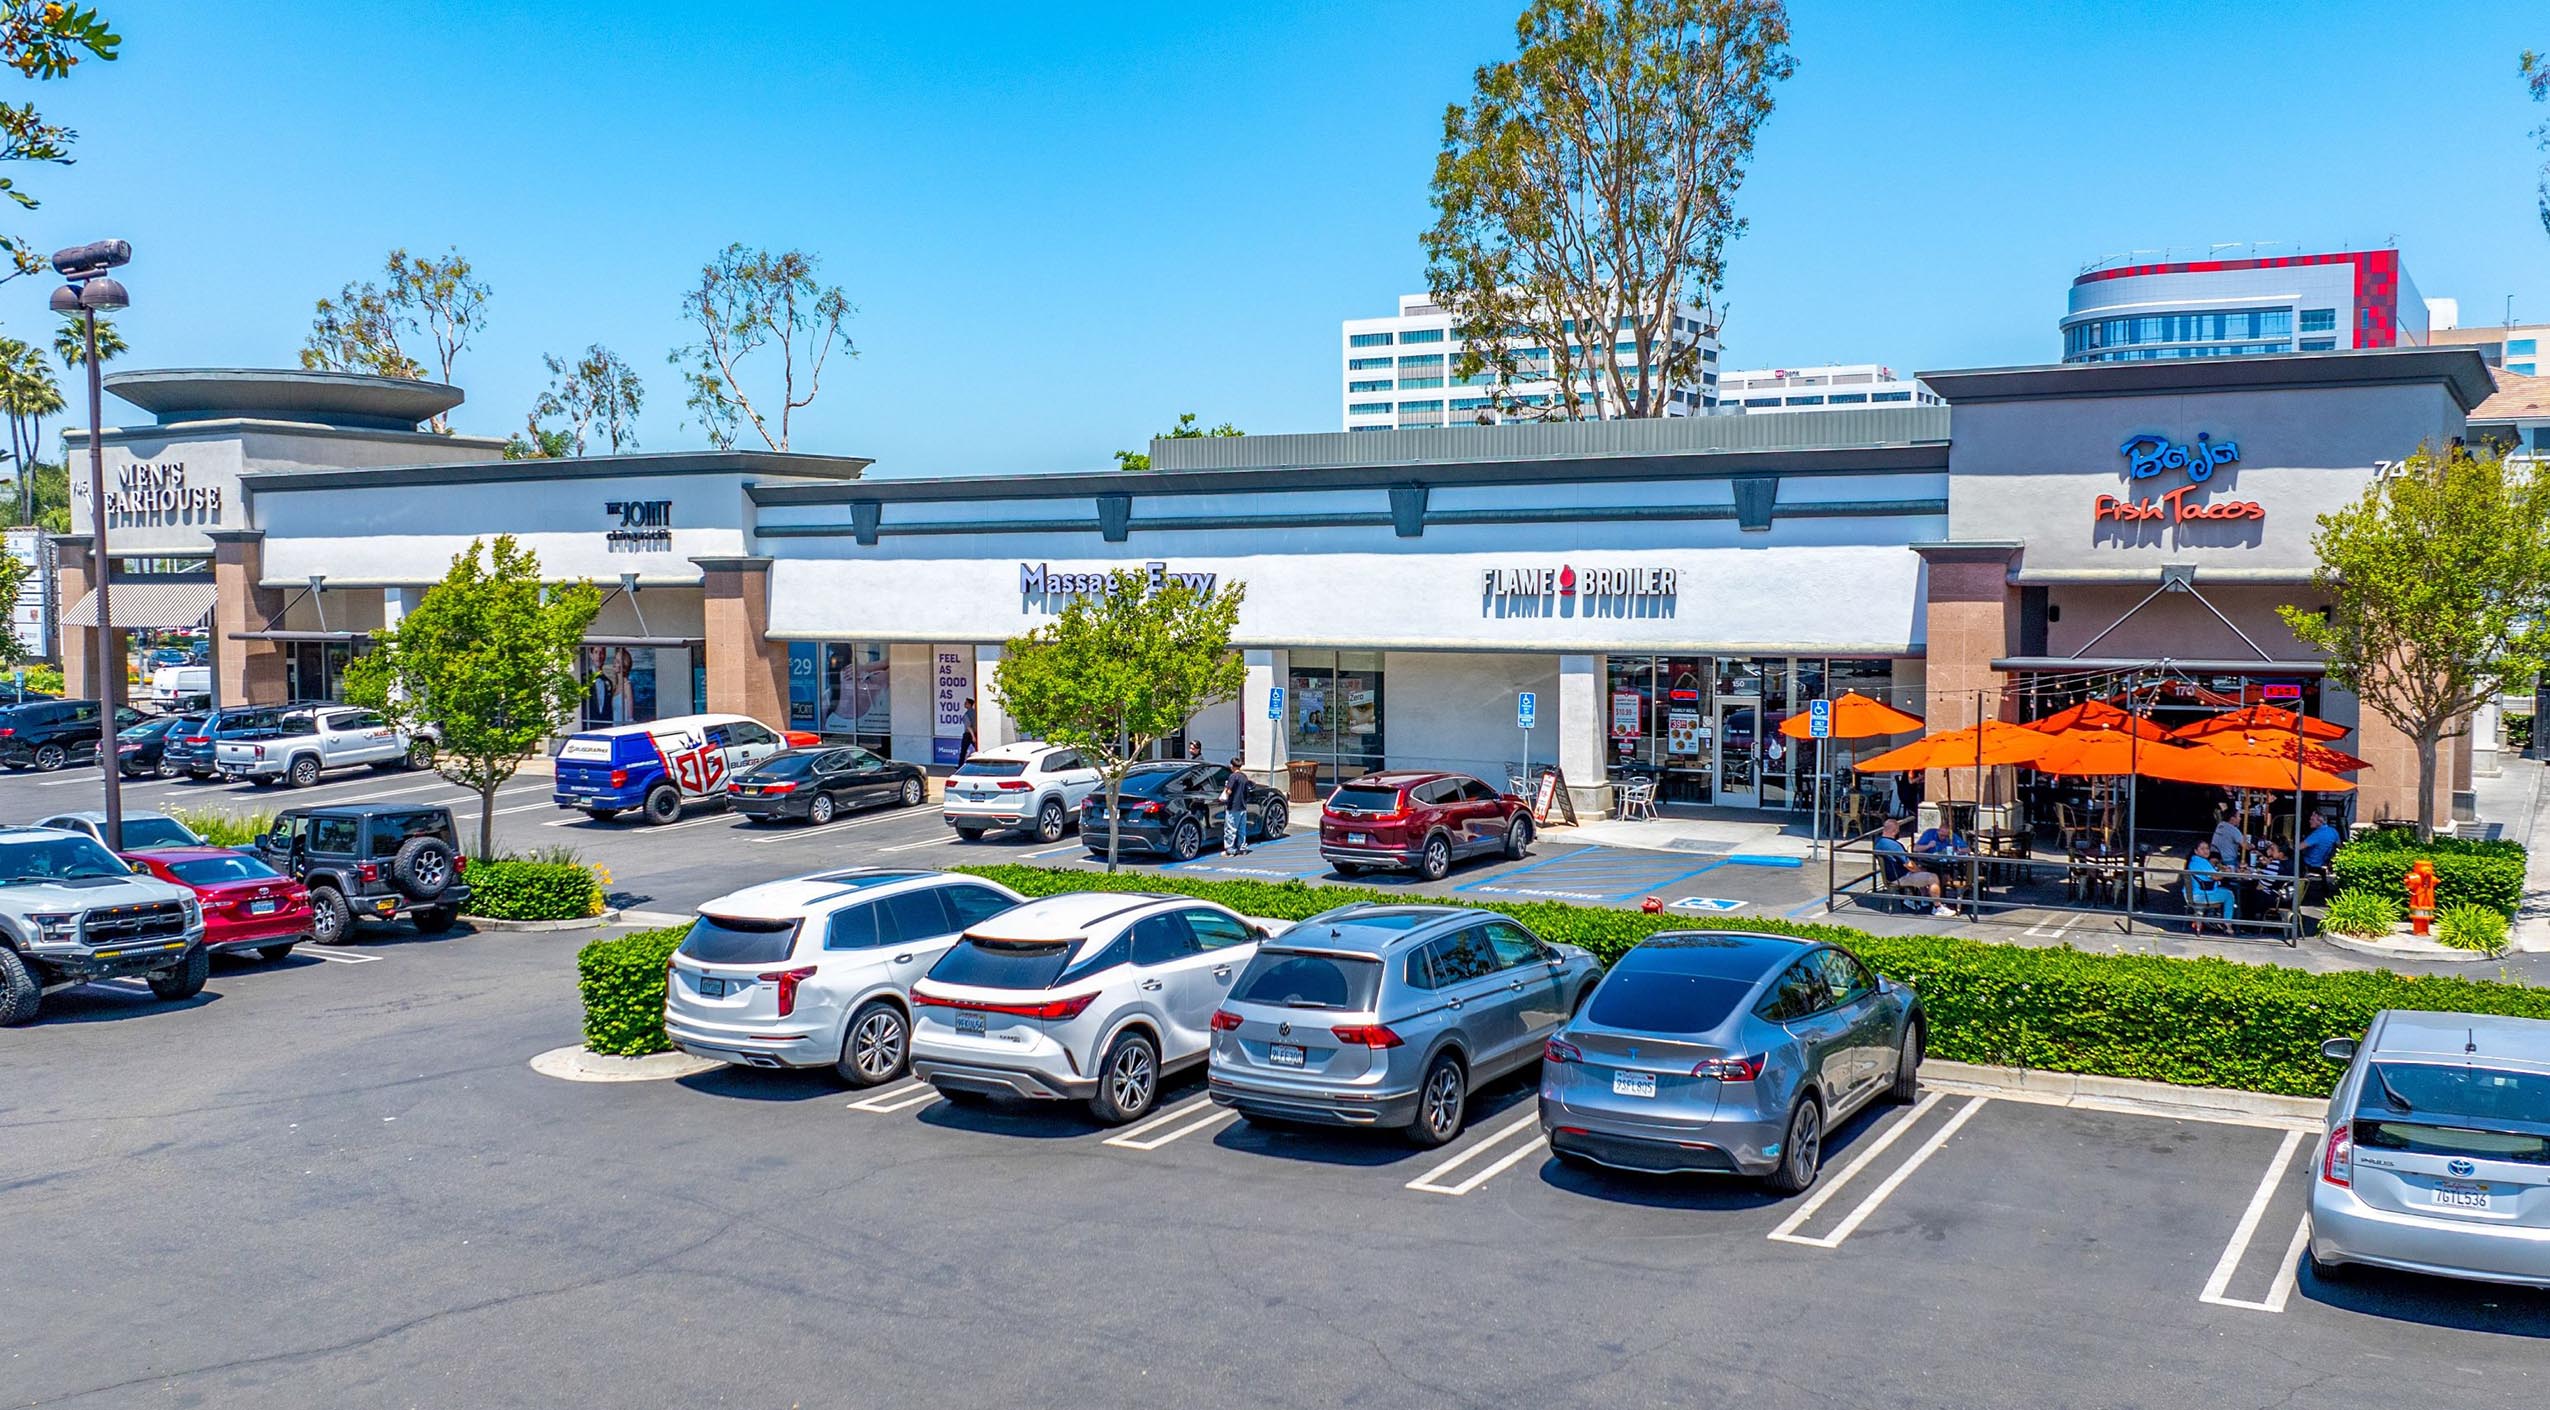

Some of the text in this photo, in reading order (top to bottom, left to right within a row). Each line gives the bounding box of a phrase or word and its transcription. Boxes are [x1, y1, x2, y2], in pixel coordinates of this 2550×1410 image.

[2119, 431, 2241, 483] Baja
[118, 462, 185, 486] MEN'S
[2095, 484, 2266, 525] Fish Tacos
[620, 500, 672, 527] JOINT
[1482, 568, 1676, 595] FLAME BROILER
[939, 654, 961, 663] FEEL
[939, 665, 952, 675] AS
[940, 677, 967, 687] GOOD
[1732, 680, 1745, 688] 150
[940, 689, 953, 699] AS
[2175, 686, 2195, 697] 170
[1350, 693, 1364, 701] Zero
[940, 702, 960, 712] YOU
[2361, 1157, 2395, 1167] PRIUS
[2443, 1181, 2479, 1191] California
[2436, 1189, 2487, 1208] 7GTL536
